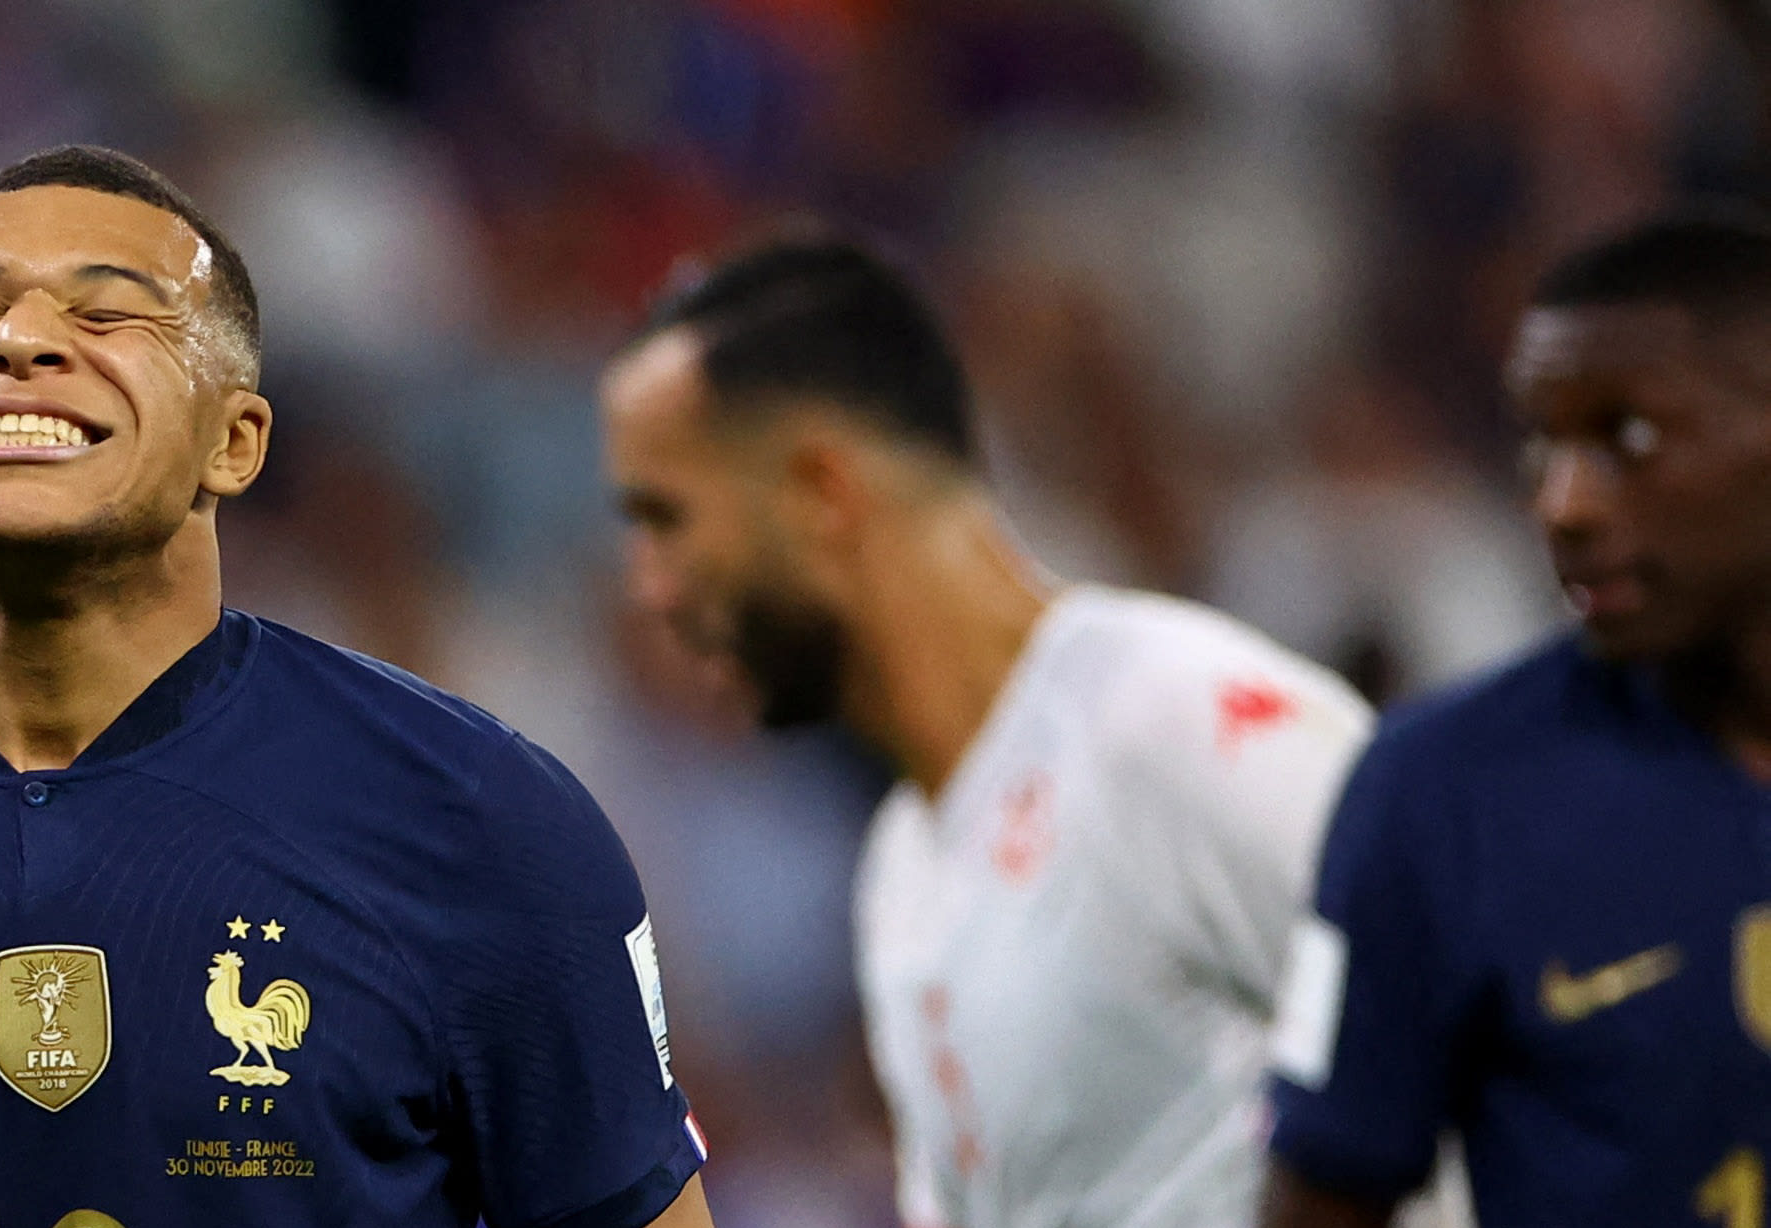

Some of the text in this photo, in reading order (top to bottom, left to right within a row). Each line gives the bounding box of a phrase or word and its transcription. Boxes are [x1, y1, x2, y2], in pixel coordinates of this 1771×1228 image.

[27, 1050, 77, 1069] FIFA
[39, 1078, 67, 1090] 2018
[186, 1140, 231, 1158] TUNISIE
[246, 1140, 297, 1157] FRANCE
[165, 1158, 315, 1178] 30 NOVEMBRE 2022
